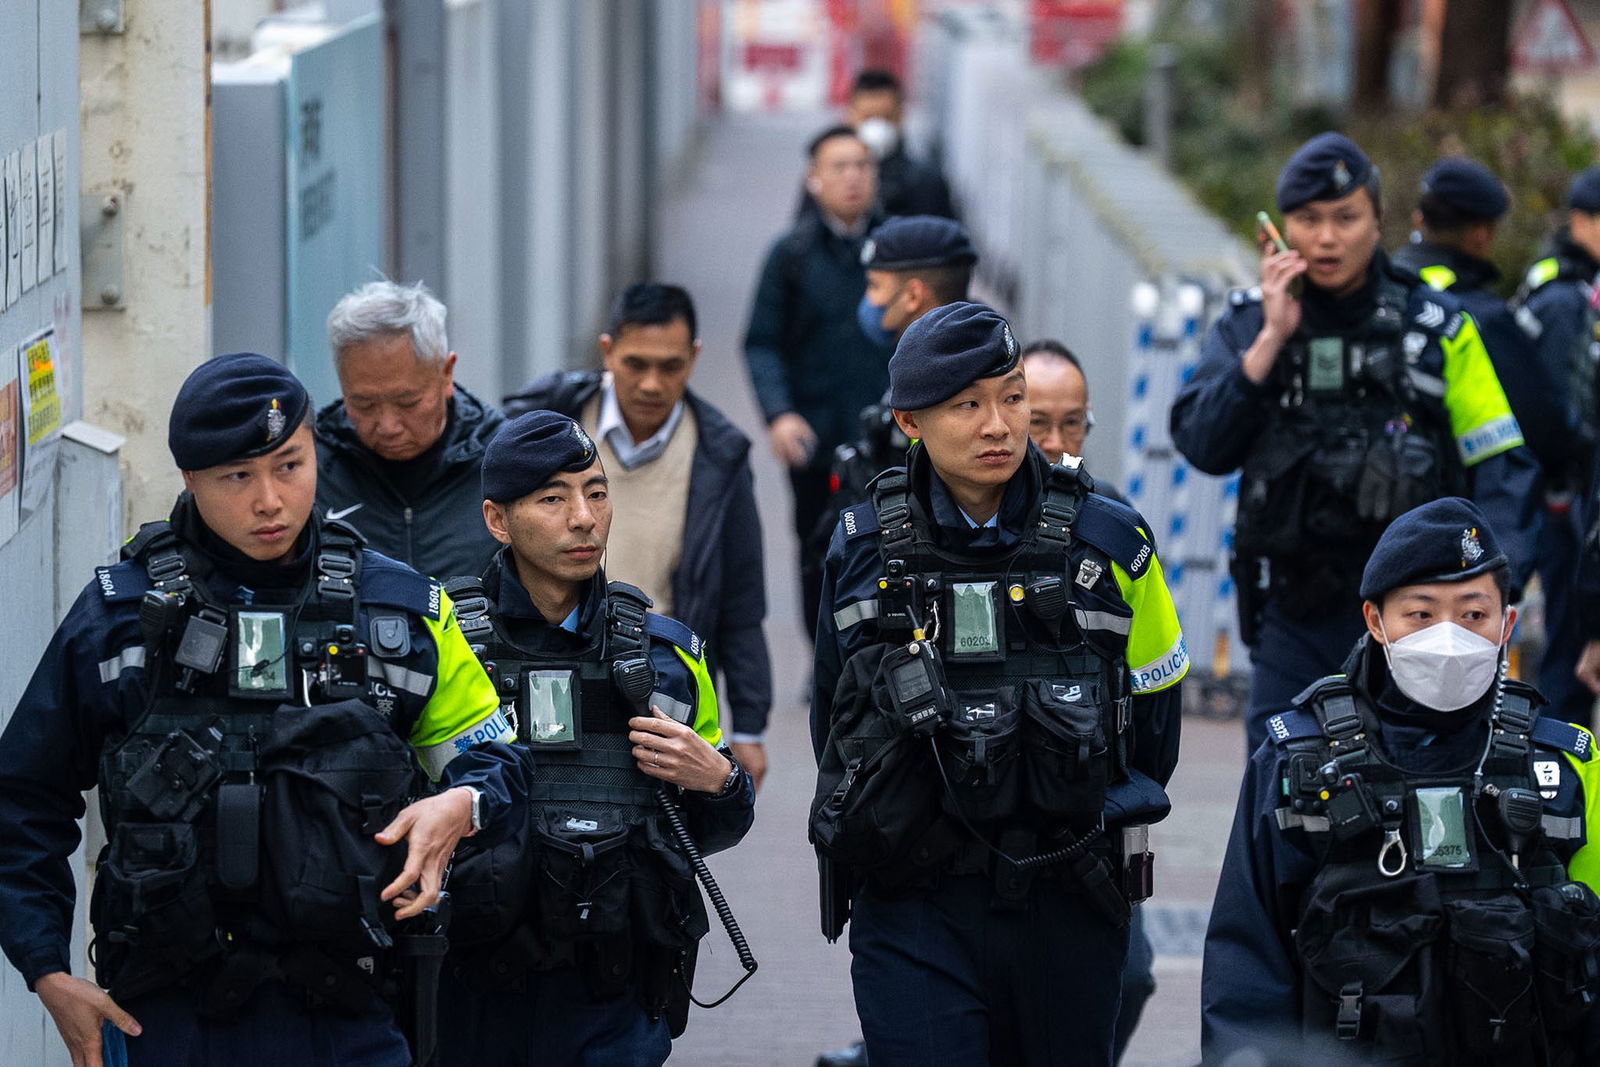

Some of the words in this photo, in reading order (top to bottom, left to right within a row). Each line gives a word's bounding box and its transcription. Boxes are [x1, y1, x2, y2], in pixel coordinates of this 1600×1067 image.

[844, 511, 857, 535] 60203
[1130, 544, 1151, 573] 60203
[98, 569, 116, 597] 18604
[428, 584, 440, 615] 18604
[243, 669, 276, 681] 104
[1140, 646, 1185, 686] POLICE
[1270, 716, 1290, 739] 35375
[1574, 730, 1590, 754] 35375
